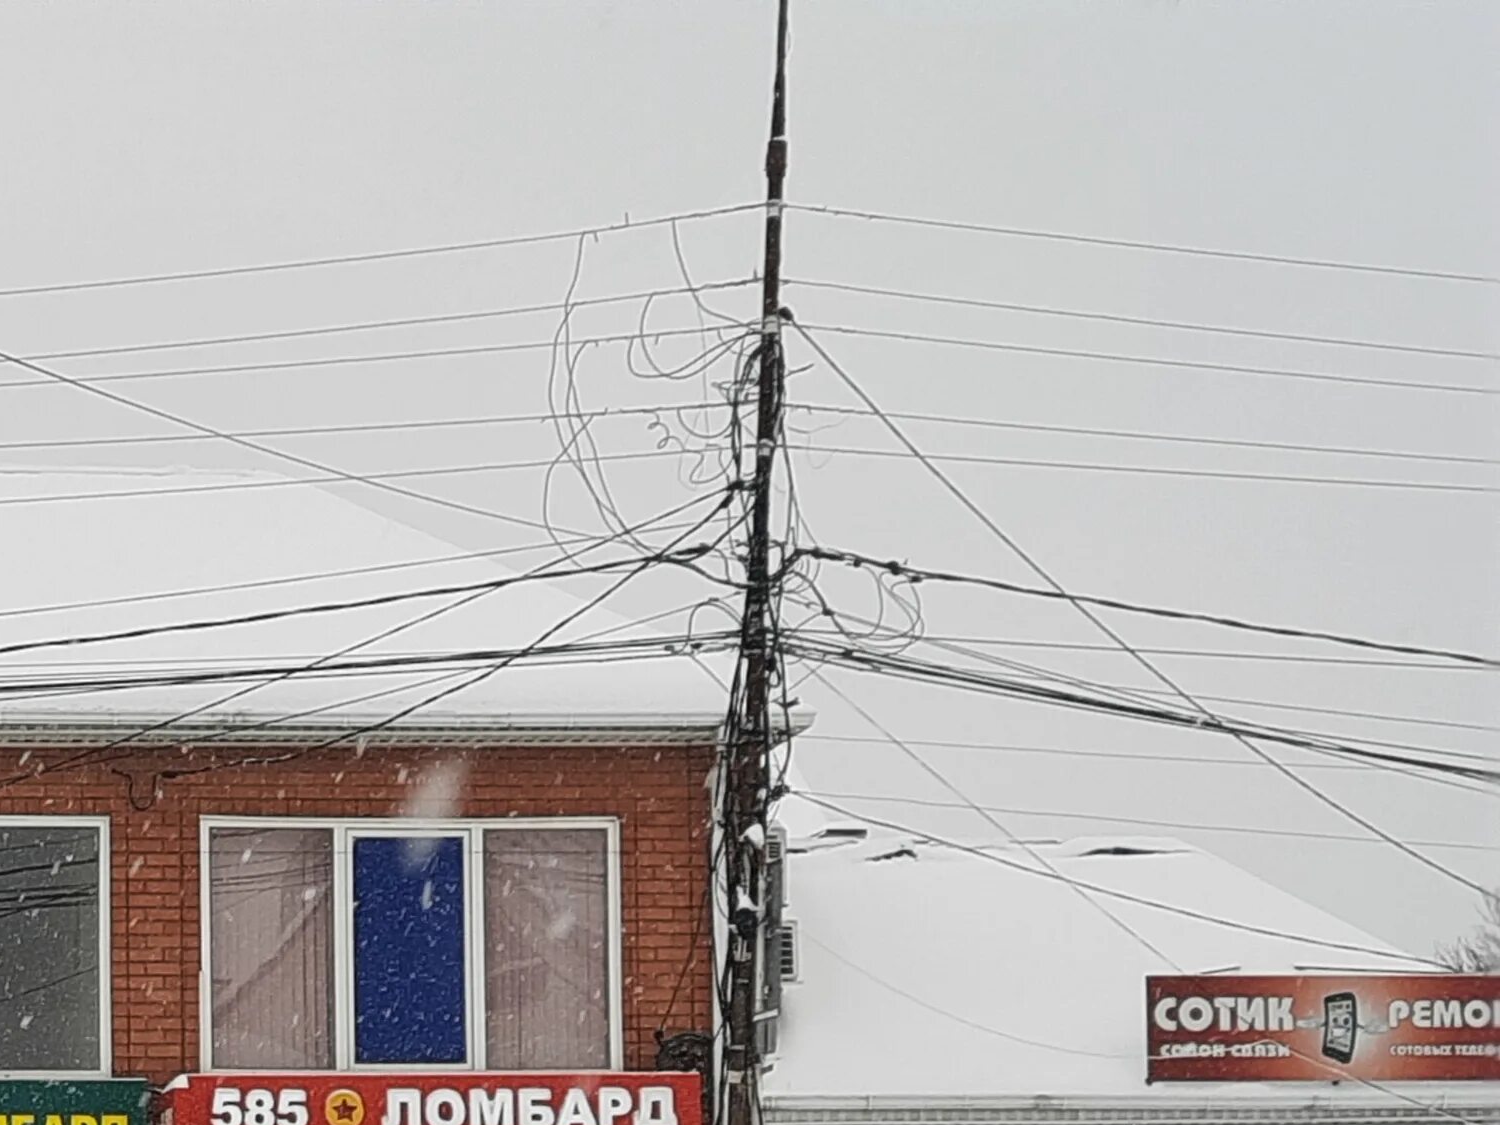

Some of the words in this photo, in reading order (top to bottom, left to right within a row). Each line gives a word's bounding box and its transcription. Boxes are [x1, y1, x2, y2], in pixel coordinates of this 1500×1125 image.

[1153, 996, 1294, 1032] СОТИК
[1389, 999, 1500, 1029] РЕМО
[1390, 1044, 1453, 1056] СОТОВЫХ
